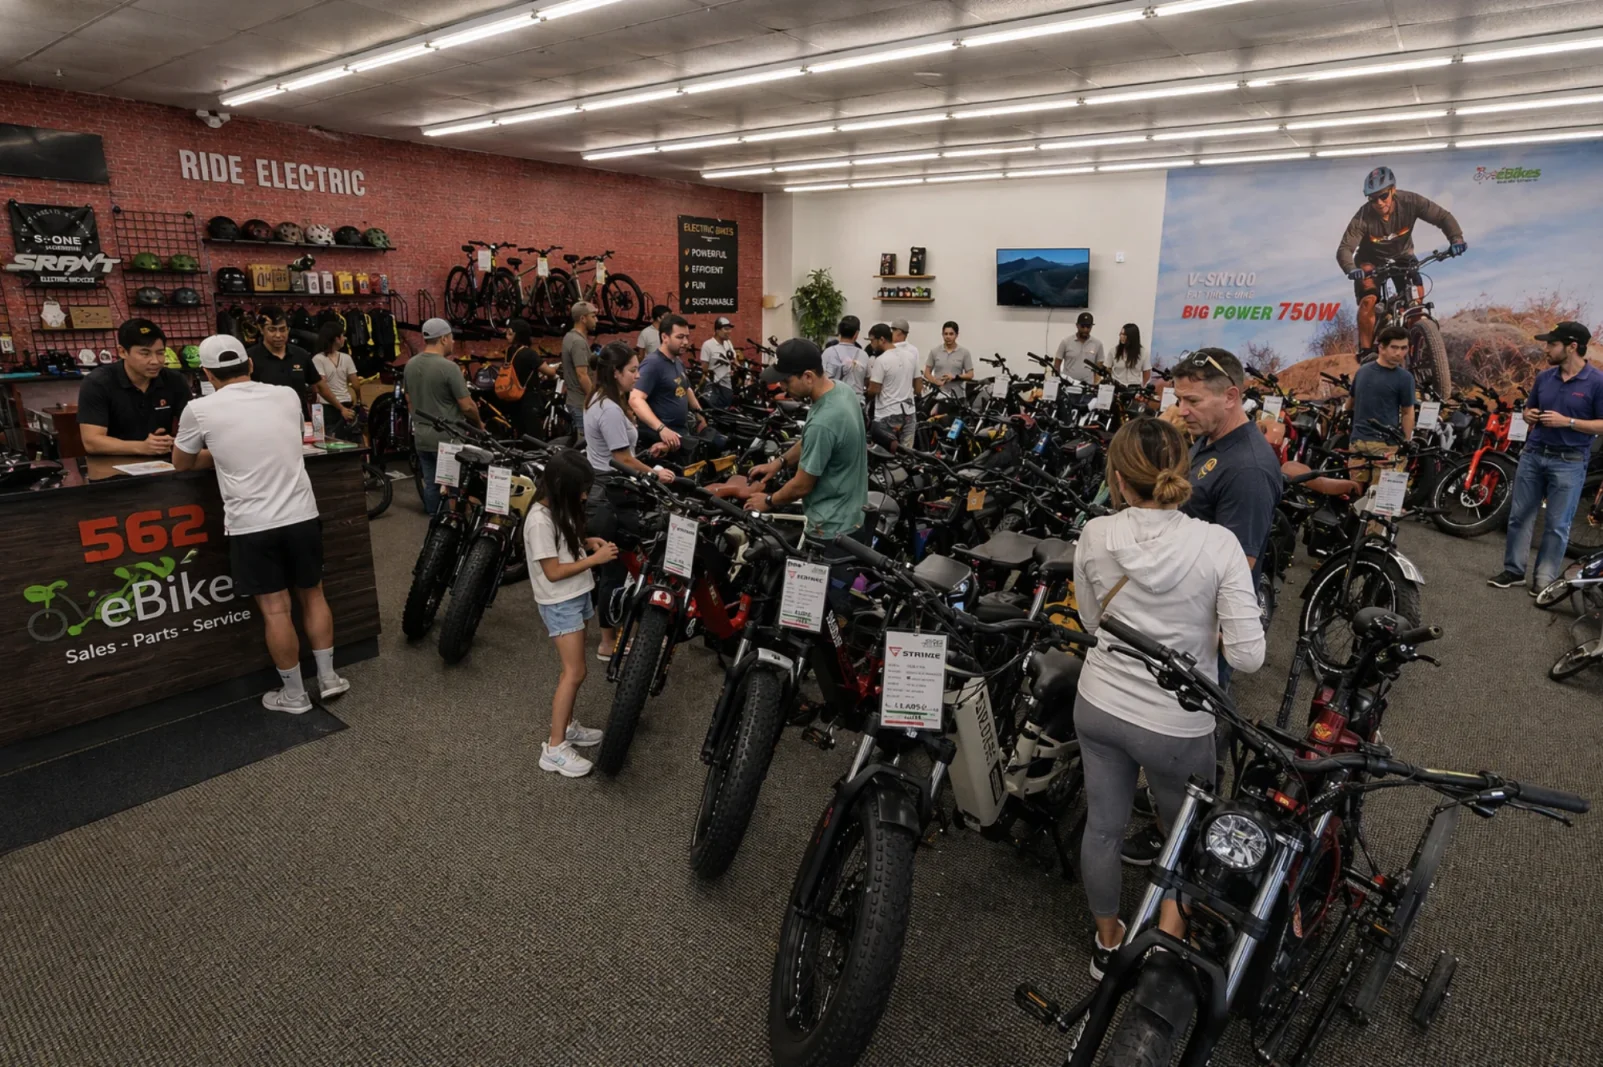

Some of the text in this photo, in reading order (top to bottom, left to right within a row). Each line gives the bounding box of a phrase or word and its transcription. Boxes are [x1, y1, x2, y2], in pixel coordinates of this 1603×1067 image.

[179, 149, 366, 197] RIDE ELECTRIC
[683, 222, 714, 234] ELECTRIC
[691, 248, 727, 259] POWERFUL
[691, 265, 724, 274] EFFICIENT
[691, 281, 706, 290] FUN
[692, 298, 734, 306] SUSTAINABLE
[1181, 302, 1341, 321] BIG POWER 750W
[78, 504, 208, 563] 562
[65, 644, 117, 664] Sales
[133, 627, 179, 648] Parts
[193, 610, 251, 632] Service
